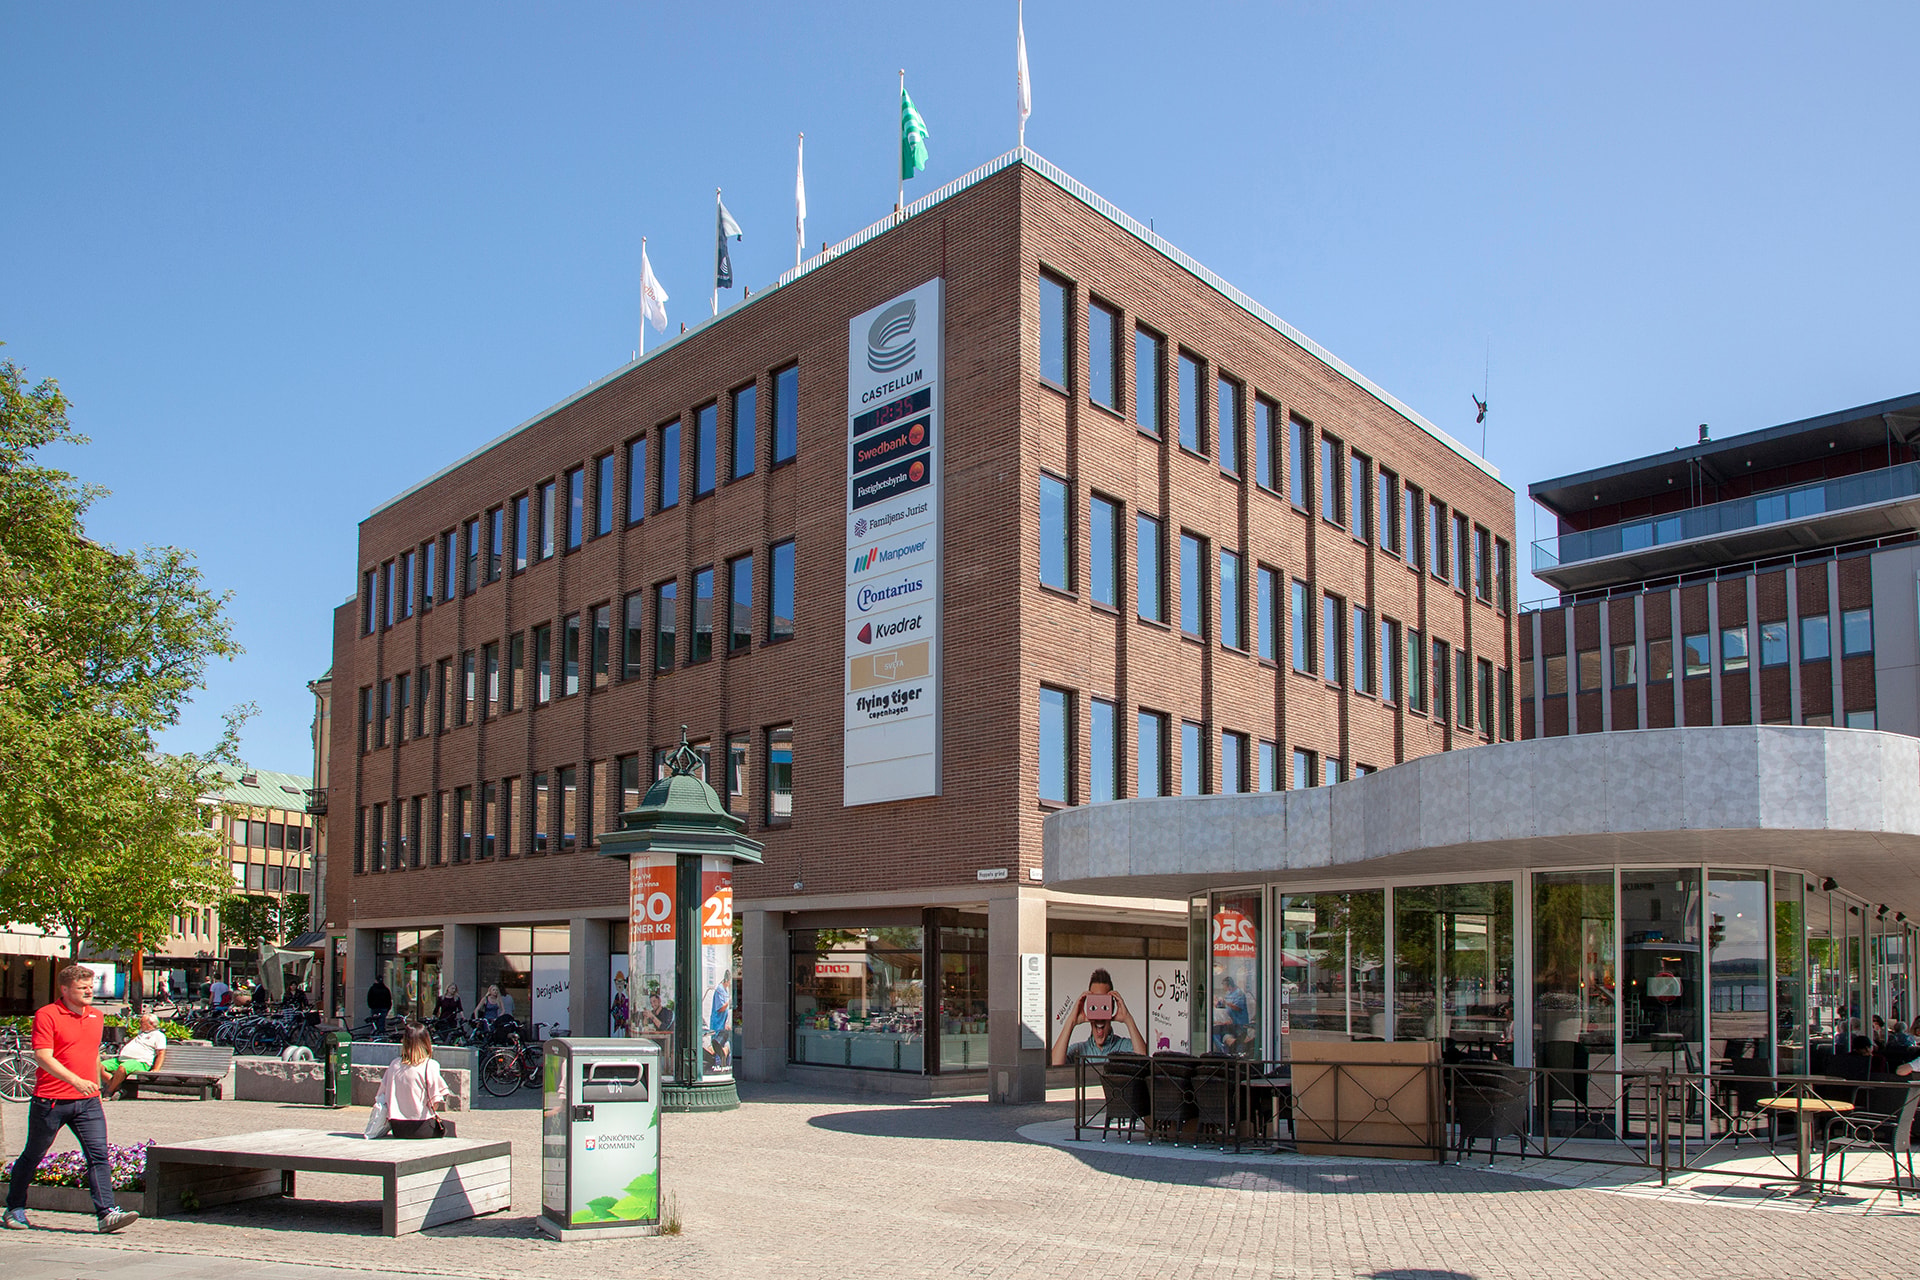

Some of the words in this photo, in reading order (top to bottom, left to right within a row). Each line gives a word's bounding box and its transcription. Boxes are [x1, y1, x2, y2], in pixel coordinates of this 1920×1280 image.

[861, 368, 923, 404] CASTELLUM
[876, 396, 913, 426] 12:35
[857, 433, 908, 462] Swedbank
[869, 511, 905, 530] Familjens
[905, 502, 928, 518] Jurist
[879, 540, 926, 563] Manpower
[863, 578, 923, 605] Pontarius
[875, 614, 922, 639] Kvadrat
[856, 694, 890, 713] flying
[890, 687, 922, 706] tiger
[868, 706, 908, 719] copenhagen
[655, 923, 671, 933] KR
[536, 980, 563, 999] Designed
[598, 1142, 636, 1150] KOMMUN
